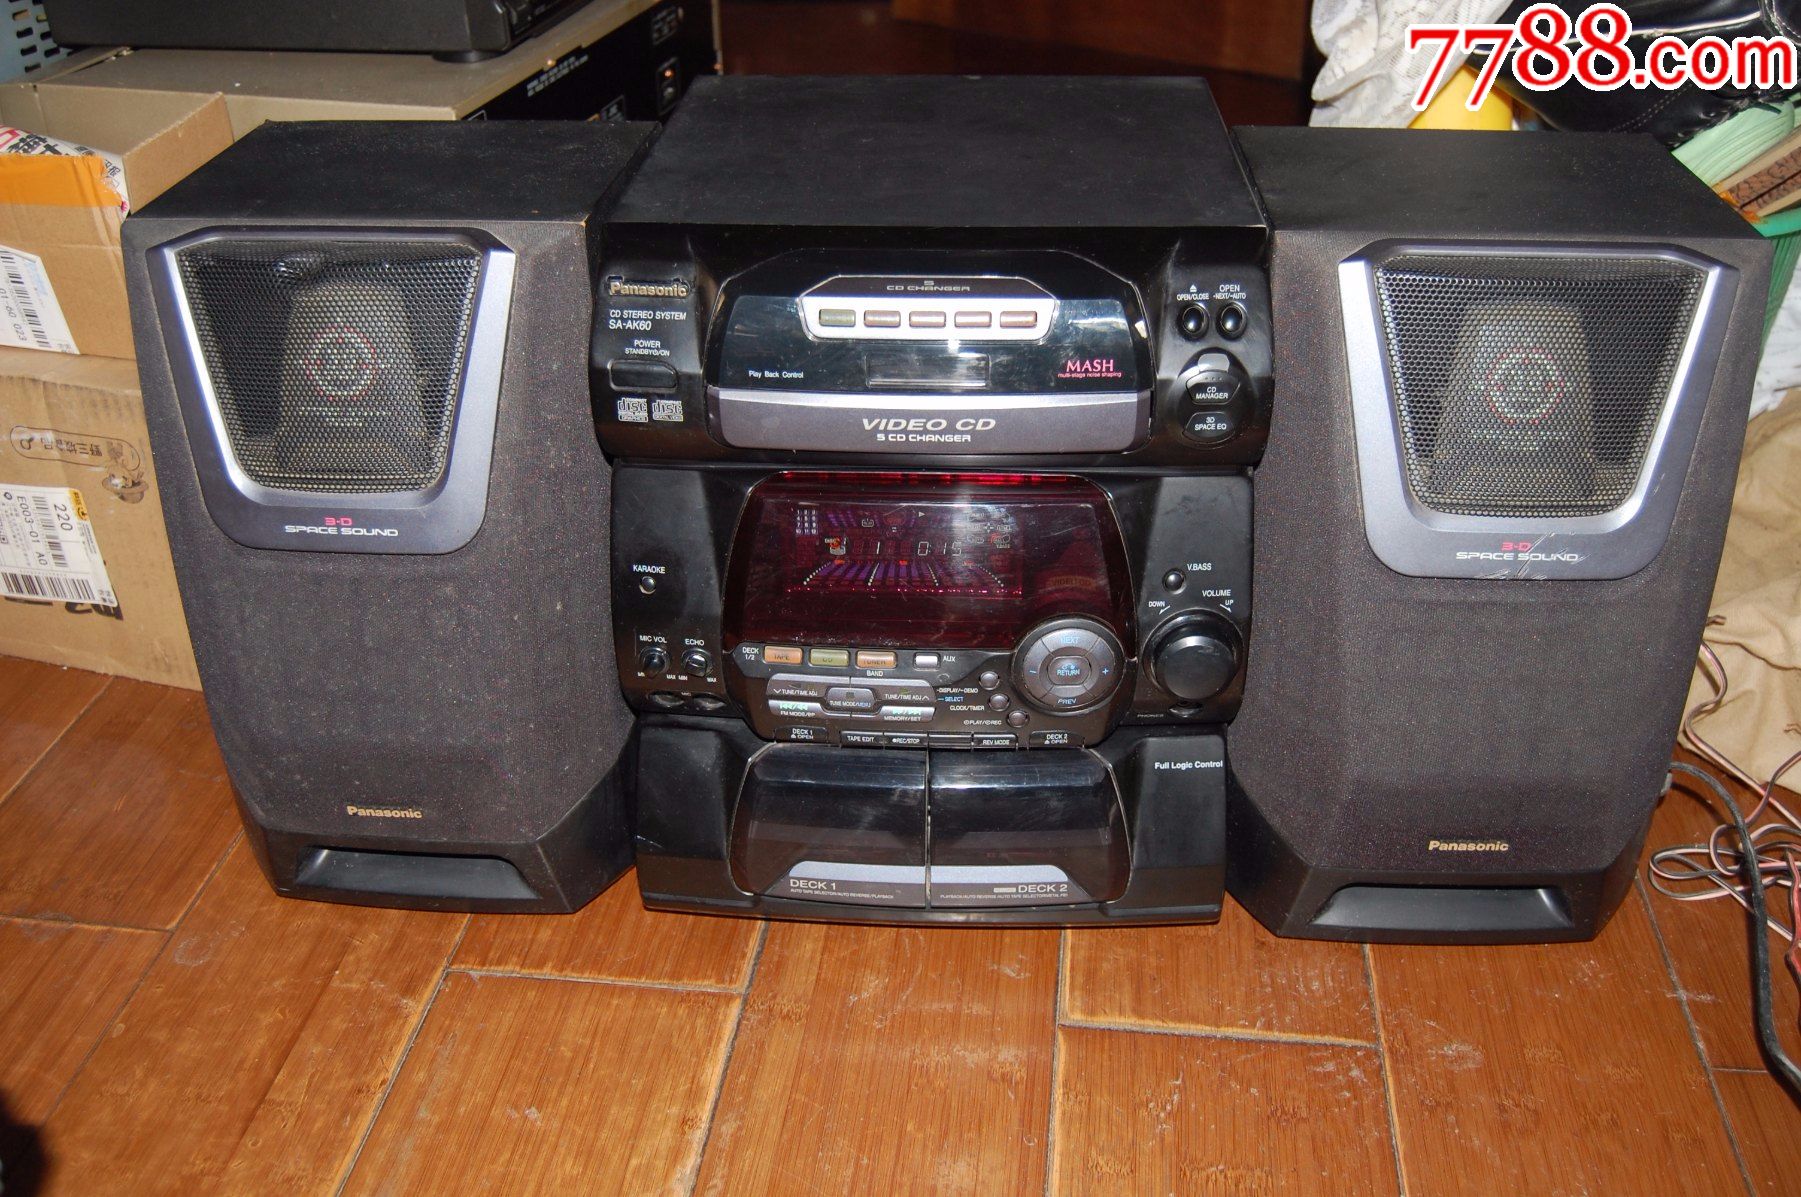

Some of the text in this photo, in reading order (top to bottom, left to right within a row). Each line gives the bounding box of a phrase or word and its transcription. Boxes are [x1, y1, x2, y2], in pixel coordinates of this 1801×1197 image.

[610, 282, 689, 297] Panasonic
[1219, 284, 1240, 292] OPEN
[610, 309, 686, 320] CD STEREO SYSTEM
[609, 319, 651, 330] SA-AK60
[634, 339, 660, 348] POWER
[1066, 359, 1114, 372] MASH
[748, 370, 804, 379] Play Back Control
[1195, 392, 1228, 400] MANAGER
[862, 418, 996, 431] VIDEO CD
[1205, 416, 1215, 424] 3D
[1195, 423, 1215, 431] SPACE
[876, 433, 971, 443] 5 CD CHANGER
[54, 504, 73, 532] 220
[325, 517, 352, 526] 3-D
[285, 525, 398, 537] SPACE SOUND
[1502, 542, 1532, 552] 3-D
[1456, 552, 1579, 561] SPACE SOUND
[633, 564, 665, 574] KARAOKE
[1187, 563, 1212, 571] V.BASS
[1202, 589, 1231, 597] VOLUME
[685, 638, 704, 646] ECHO
[742, 646, 759, 654] DECK
[745, 653, 755, 661] 1/2
[1155, 760, 1223, 771] Full Logic Control
[347, 805, 423, 819] Panasonic
[1428, 839, 1509, 852] Panasonic
[789, 879, 836, 890] DECK 1
[1018, 884, 1068, 893] DECK 2
